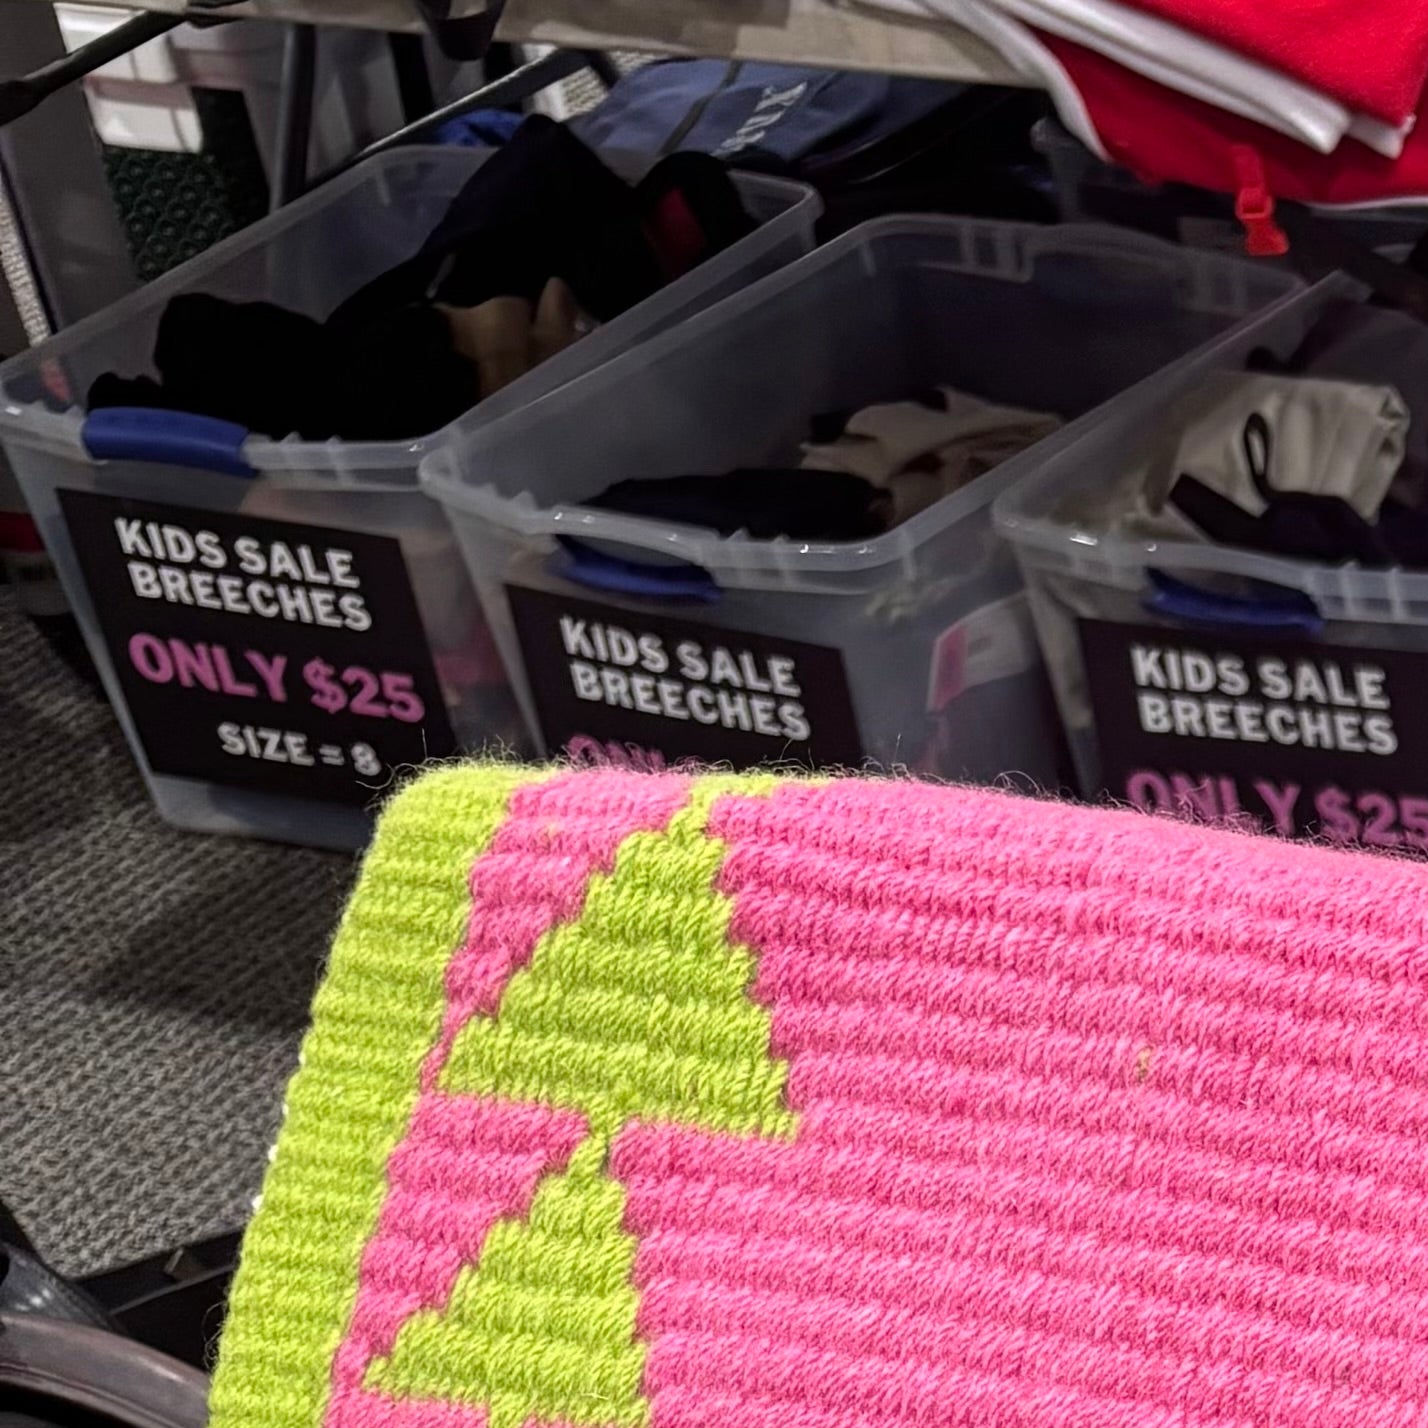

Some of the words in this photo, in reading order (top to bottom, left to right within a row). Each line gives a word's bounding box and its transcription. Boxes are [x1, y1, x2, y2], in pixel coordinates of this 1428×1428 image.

[114, 517, 227, 569] KIDS
[234, 536, 360, 589] SALE
[127, 561, 372, 631] BREECHES
[129, 632, 288, 702] ONLY
[302, 656, 425, 723] $25
[559, 614, 669, 673] KIDS
[676, 640, 801, 697] SALE
[1130, 645, 1249, 696] KIDS
[1257, 656, 1391, 710] SALE
[570, 660, 811, 741] BREECHES
[1136, 692, 1398, 755] BREECHES
[217, 721, 315, 766] SIZE
[351, 742, 382, 776] 8
